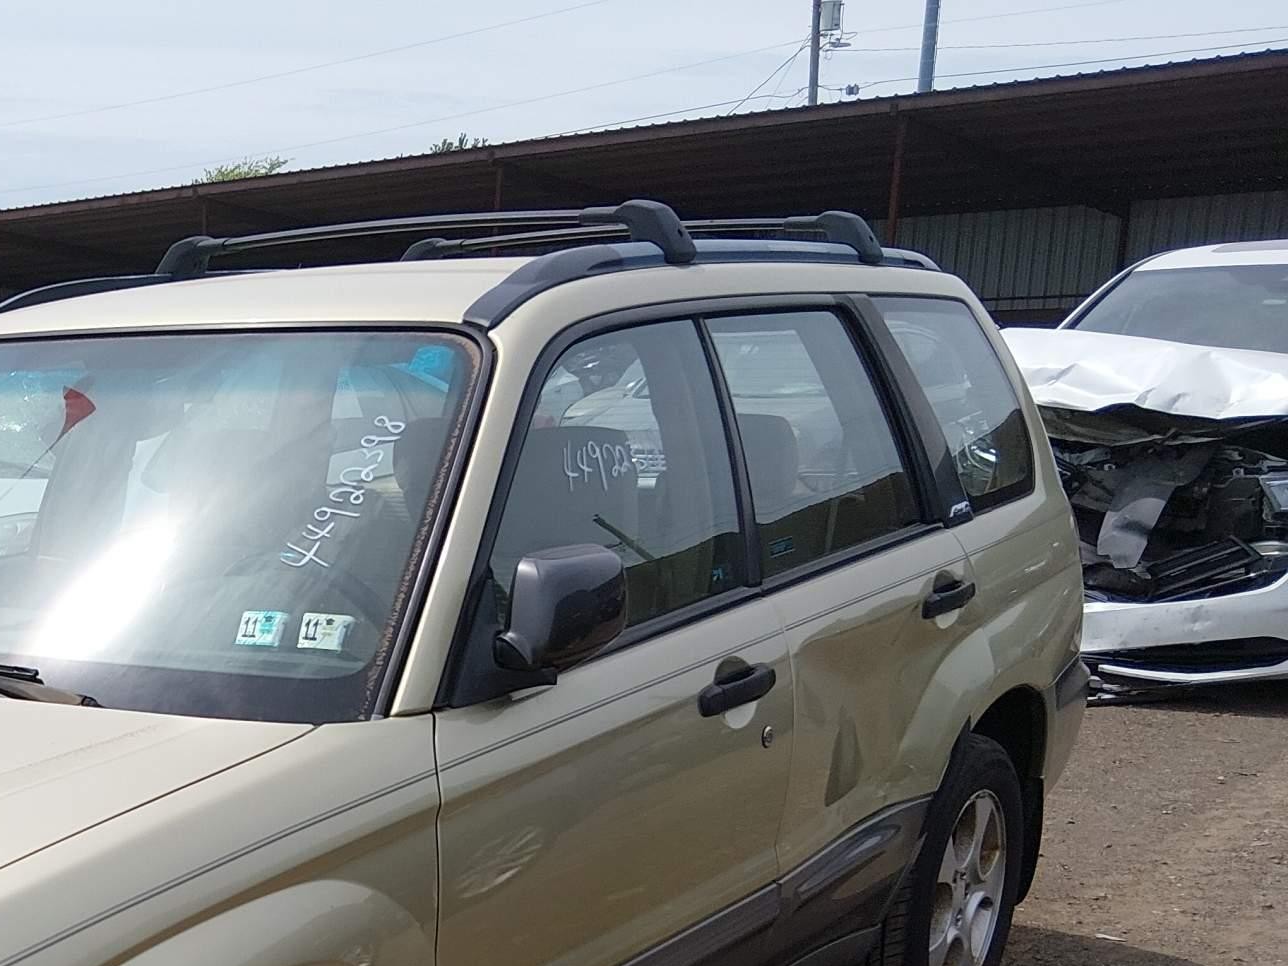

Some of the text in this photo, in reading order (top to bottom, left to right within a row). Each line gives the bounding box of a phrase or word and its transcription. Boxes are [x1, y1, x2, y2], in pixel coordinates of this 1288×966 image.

[280, 415, 406, 568] 44922398
[241, 616, 259, 638] 11
[302, 618, 320, 641] 11
